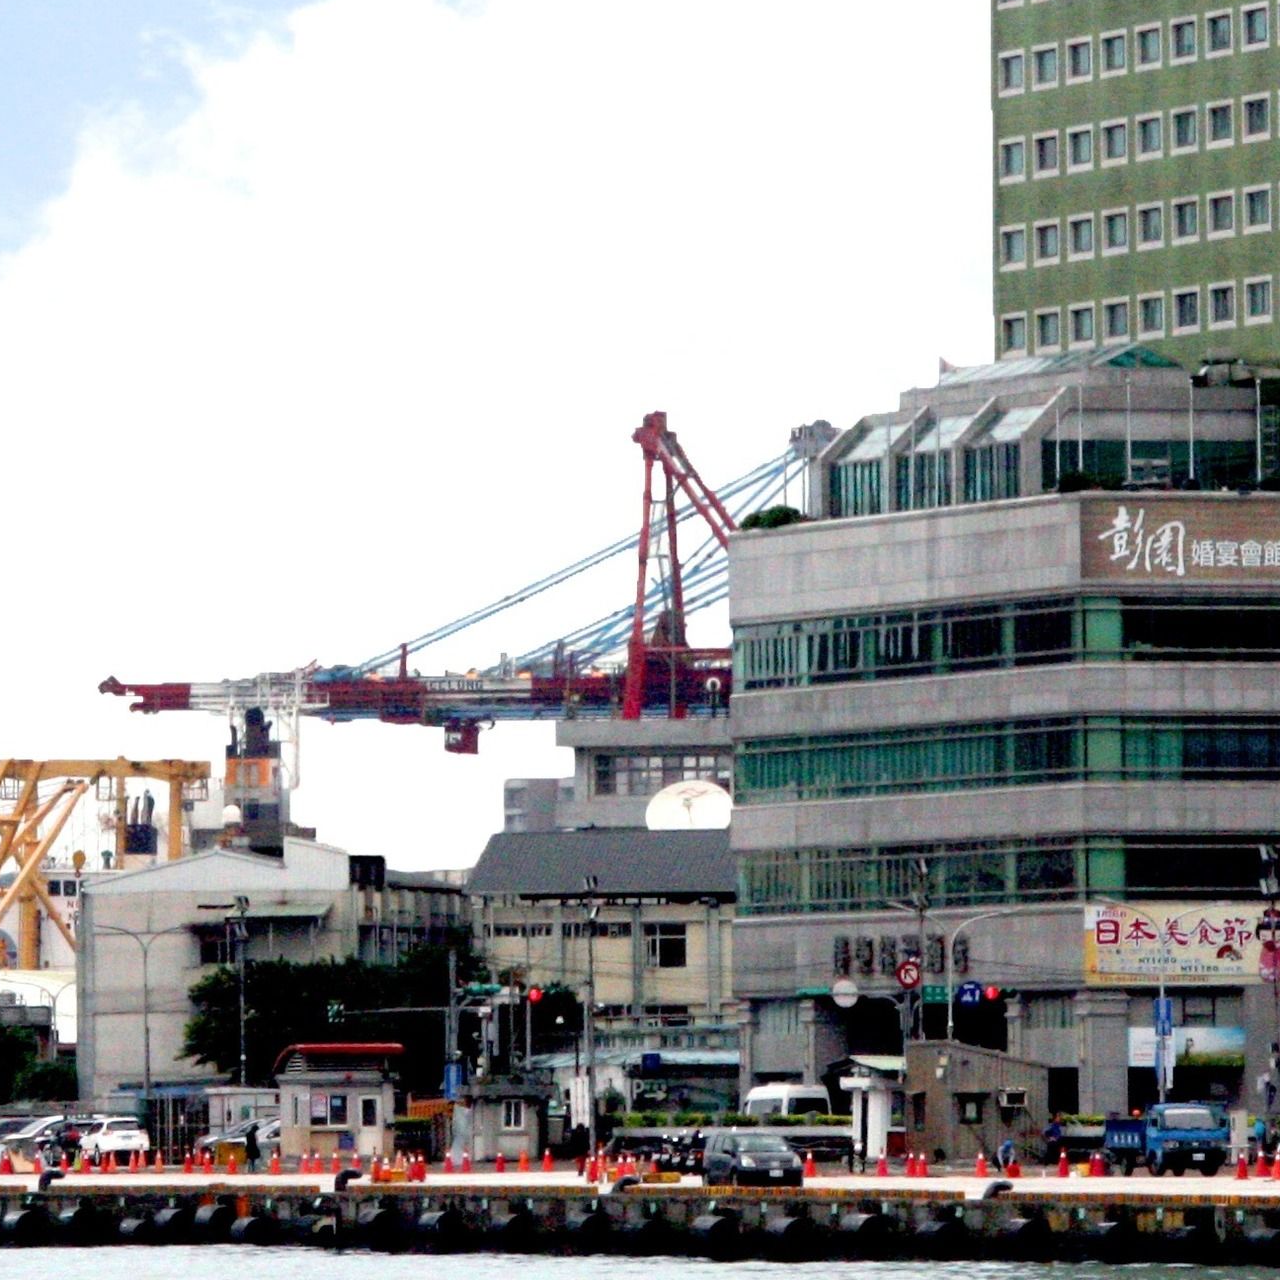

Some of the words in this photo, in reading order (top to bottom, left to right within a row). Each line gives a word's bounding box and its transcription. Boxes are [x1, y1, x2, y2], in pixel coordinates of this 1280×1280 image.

[1095, 916, 1254, 948] 日本美食節
